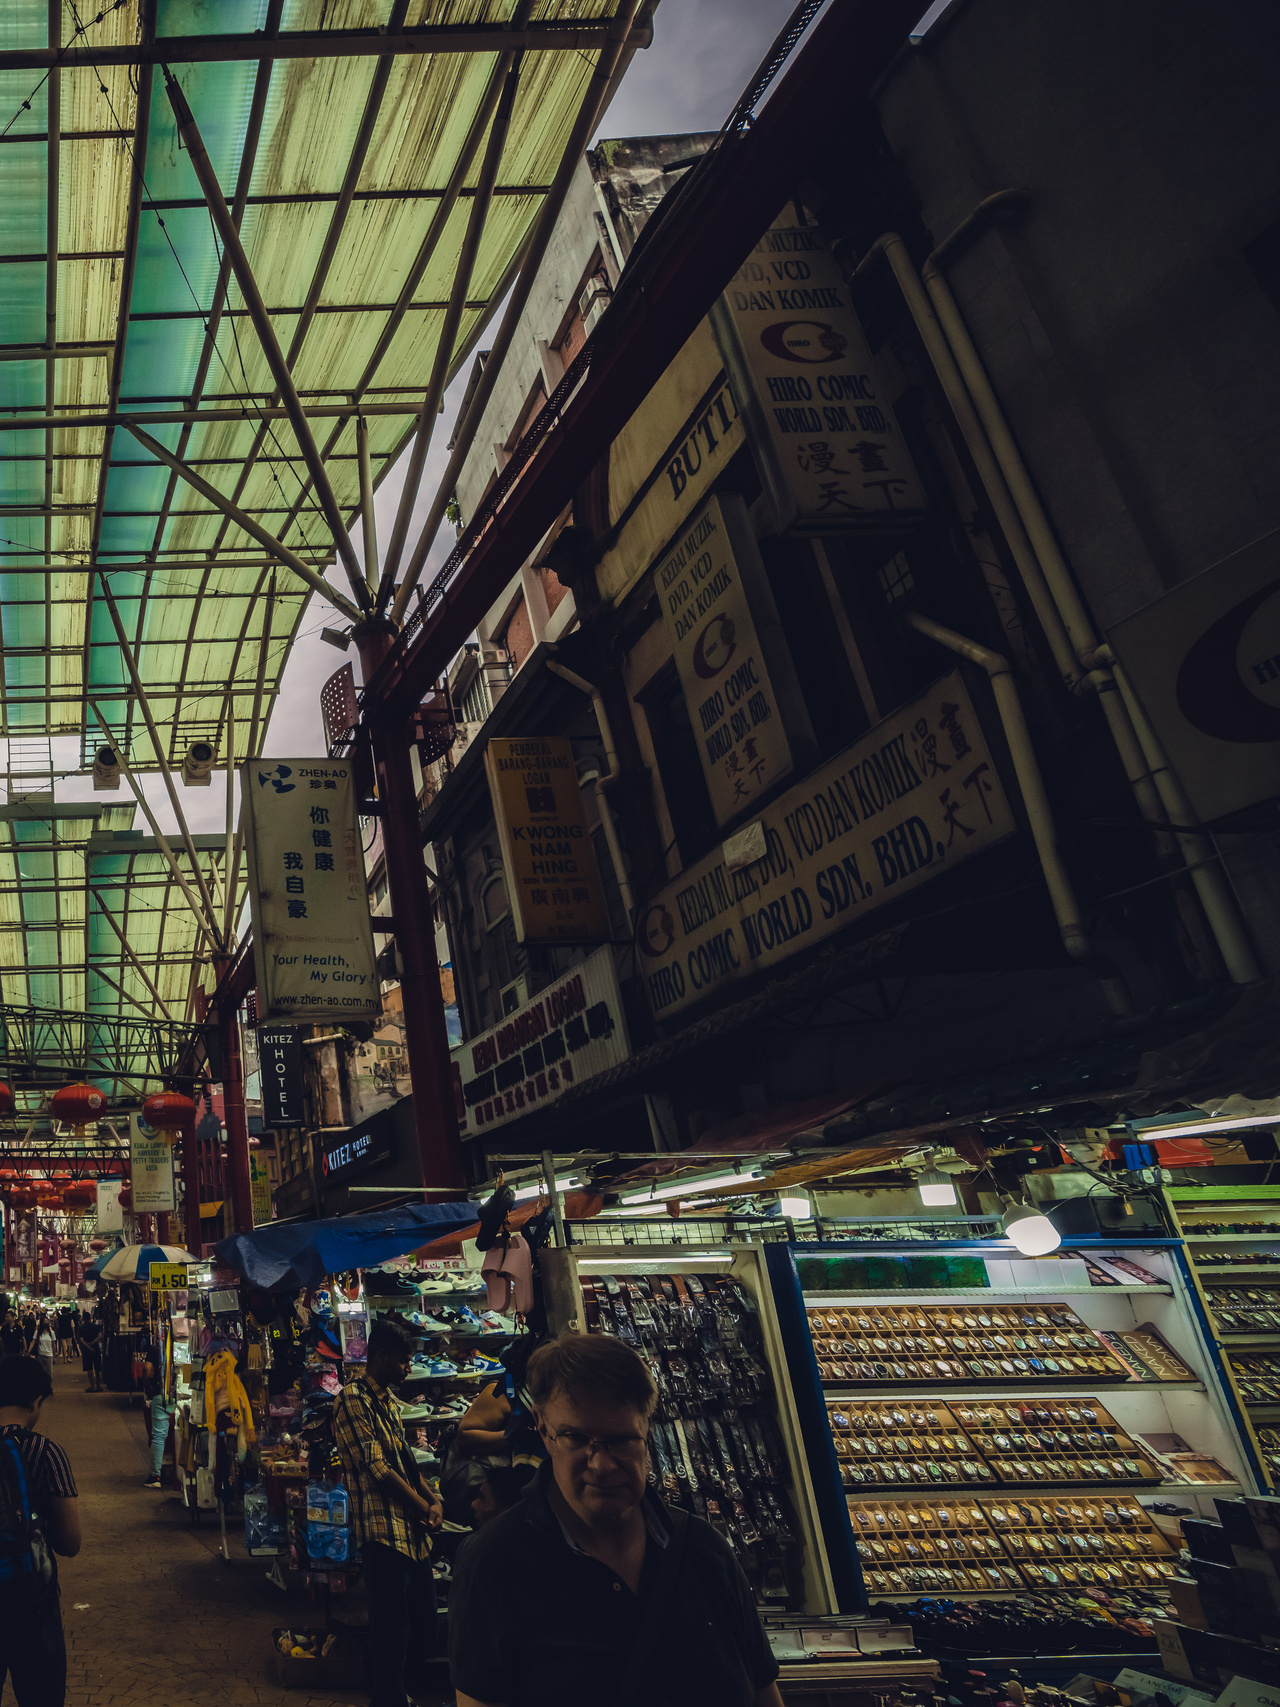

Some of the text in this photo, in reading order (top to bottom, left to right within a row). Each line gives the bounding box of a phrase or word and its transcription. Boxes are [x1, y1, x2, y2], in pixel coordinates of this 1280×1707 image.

[770, 260, 811, 281] VCD
[733, 287, 845, 311] DAN KOMIK
[766, 374, 875, 402] HIRO COMIC
[773, 408, 823, 433] WORLD
[824, 406, 858, 432] SDN.
[665, 382, 740, 500] BUTI
[815, 478, 908, 512] 天下
[660, 513, 717, 591] KEDAI MUZIK,
[667, 551, 713, 616] DVD, VCD
[674, 562, 732, 642] DAN KOMIK
[698, 656, 760, 732] HIRO COMIC
[705, 719, 733, 765] WORLD
[729, 704, 752, 742] SDN.
[510, 742, 553, 756] PEMBEKAL
[299, 769, 347, 779] ZHEN-AO
[498, 756, 569, 771] BARANG-BARANG
[523, 772, 551, 785] LOGAM
[309, 806, 335, 872] 你健康
[512, 825, 583, 841] KWONG
[675, 871, 715, 935] KEDAI
[760, 826, 796, 887] DVD,
[784, 800, 822, 860] VCD
[823, 772, 860, 845] DAN
[848, 732, 923, 824] KOMIK
[531, 842, 572, 857] NAM
[532, 860, 578, 875] HING
[283, 852, 308, 919] 我自豪
[648, 815, 945, 1012] HIRO COMIC WORLD SDN. BHD.
[273, 955, 350, 968] Your Health,
[310, 971, 328, 983] My
[332, 971, 366, 985] Glory
[274, 994, 380, 1009] www.zhen-ao.com.my
[263, 1034, 293, 1044] KITEZ
[274, 1049, 289, 1118] HOTEL
[328, 1143, 352, 1171] KITEZ
[352, 1134, 370, 1151] HOTEL
[161, 1273, 187, 1288] 1.50
[1123, 1335, 1171, 1376] NAKED
[1140, 1335, 1189, 1376] NAKED
